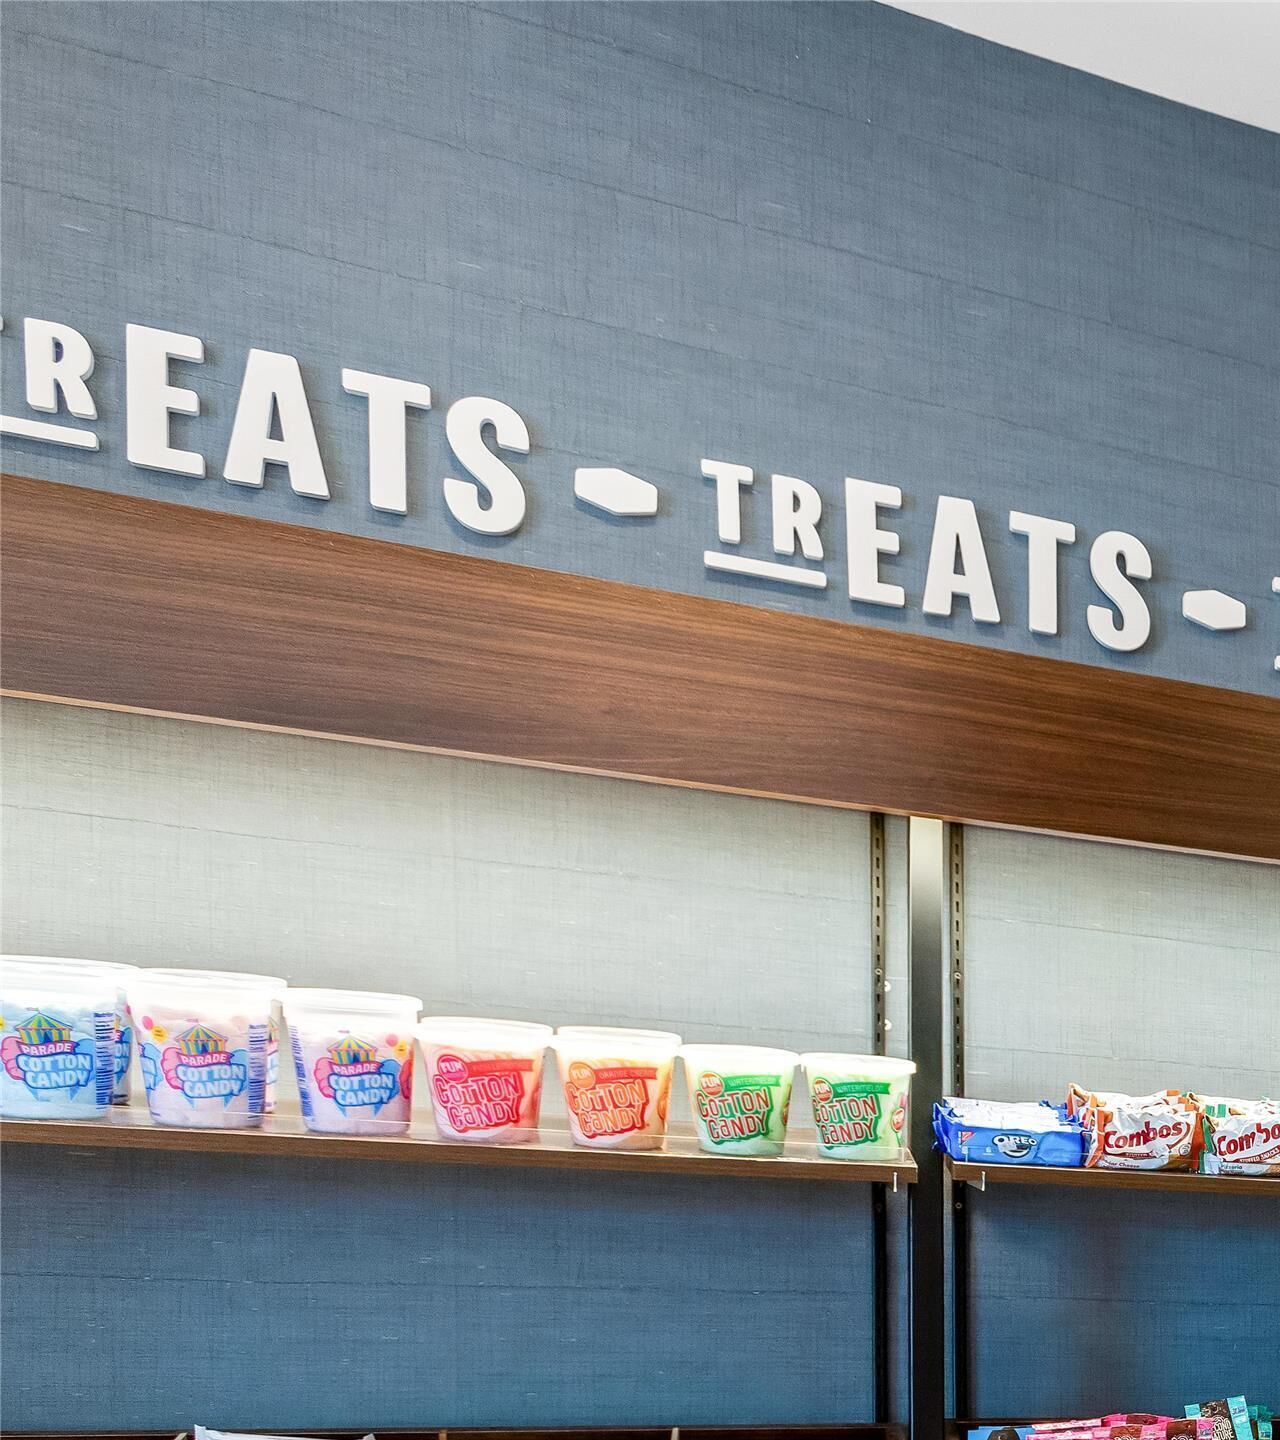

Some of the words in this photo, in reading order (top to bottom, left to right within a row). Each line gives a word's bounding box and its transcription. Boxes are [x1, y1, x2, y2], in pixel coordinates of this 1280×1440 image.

[0, 315, 531, 538] REATS
[699, 456, 1154, 653] TREATS
[22, 1042, 73, 1056] PARADE
[179, 1051, 230, 1067] PARADE
[16, 1053, 92, 1075] COTTON
[175, 1063, 246, 1084] COTTON
[332, 1061, 380, 1075] PARADE
[28, 1068, 90, 1090] CANDY
[184, 1076, 242, 1099] CANDY
[329, 1072, 395, 1092] COTTON
[700, 1077, 721, 1090] FUN
[334, 1086, 390, 1107] CANDY
[434, 1073, 522, 1108] COTTON
[1104, 1120, 1185, 1152] Combos
